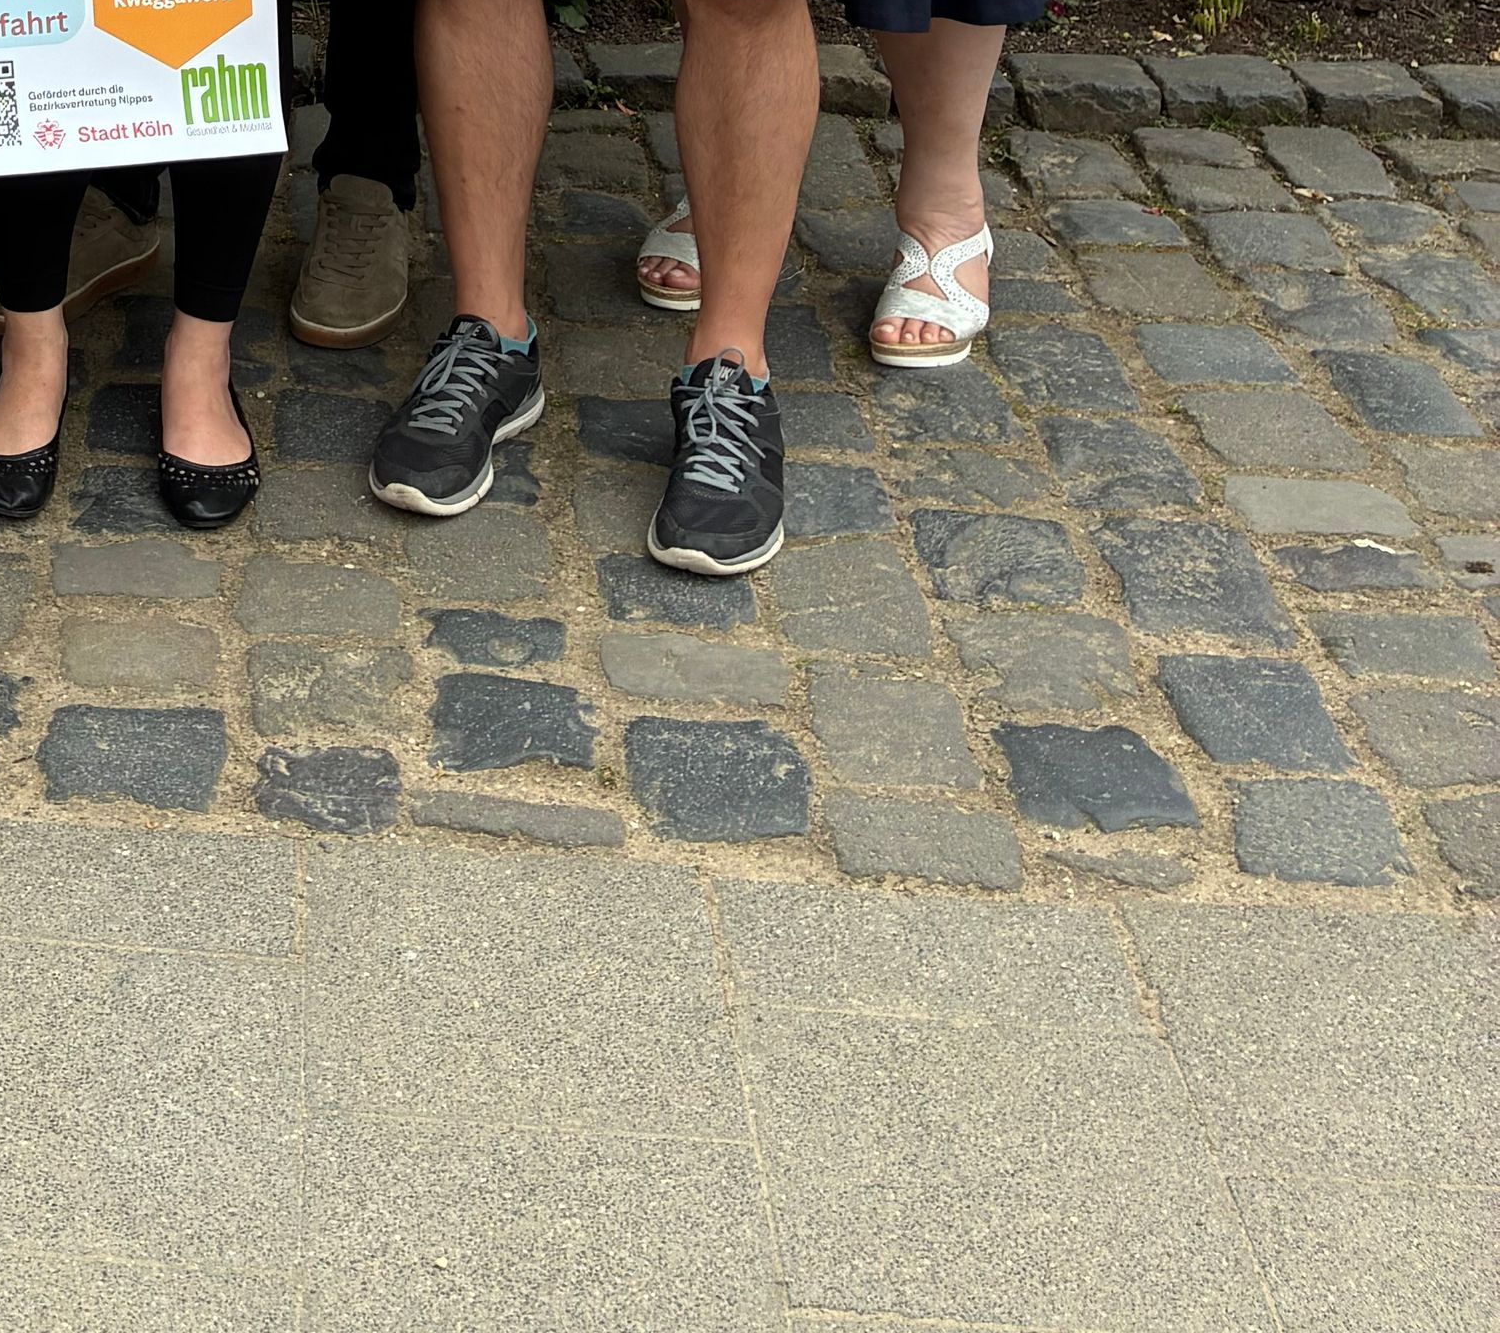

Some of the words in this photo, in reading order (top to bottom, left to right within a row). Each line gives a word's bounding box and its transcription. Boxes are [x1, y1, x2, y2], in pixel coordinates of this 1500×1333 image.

[28, 87, 77, 100] Gefördert
[78, 86, 105, 95] durch
[107, 84, 124, 94] die
[181, 54, 270, 125] rahm
[29, 97, 117, 112] Bezirksvertretung
[118, 94, 153, 105] Nippes
[78, 124, 129, 143] Stadt
[133, 120, 173, 138] Köln
